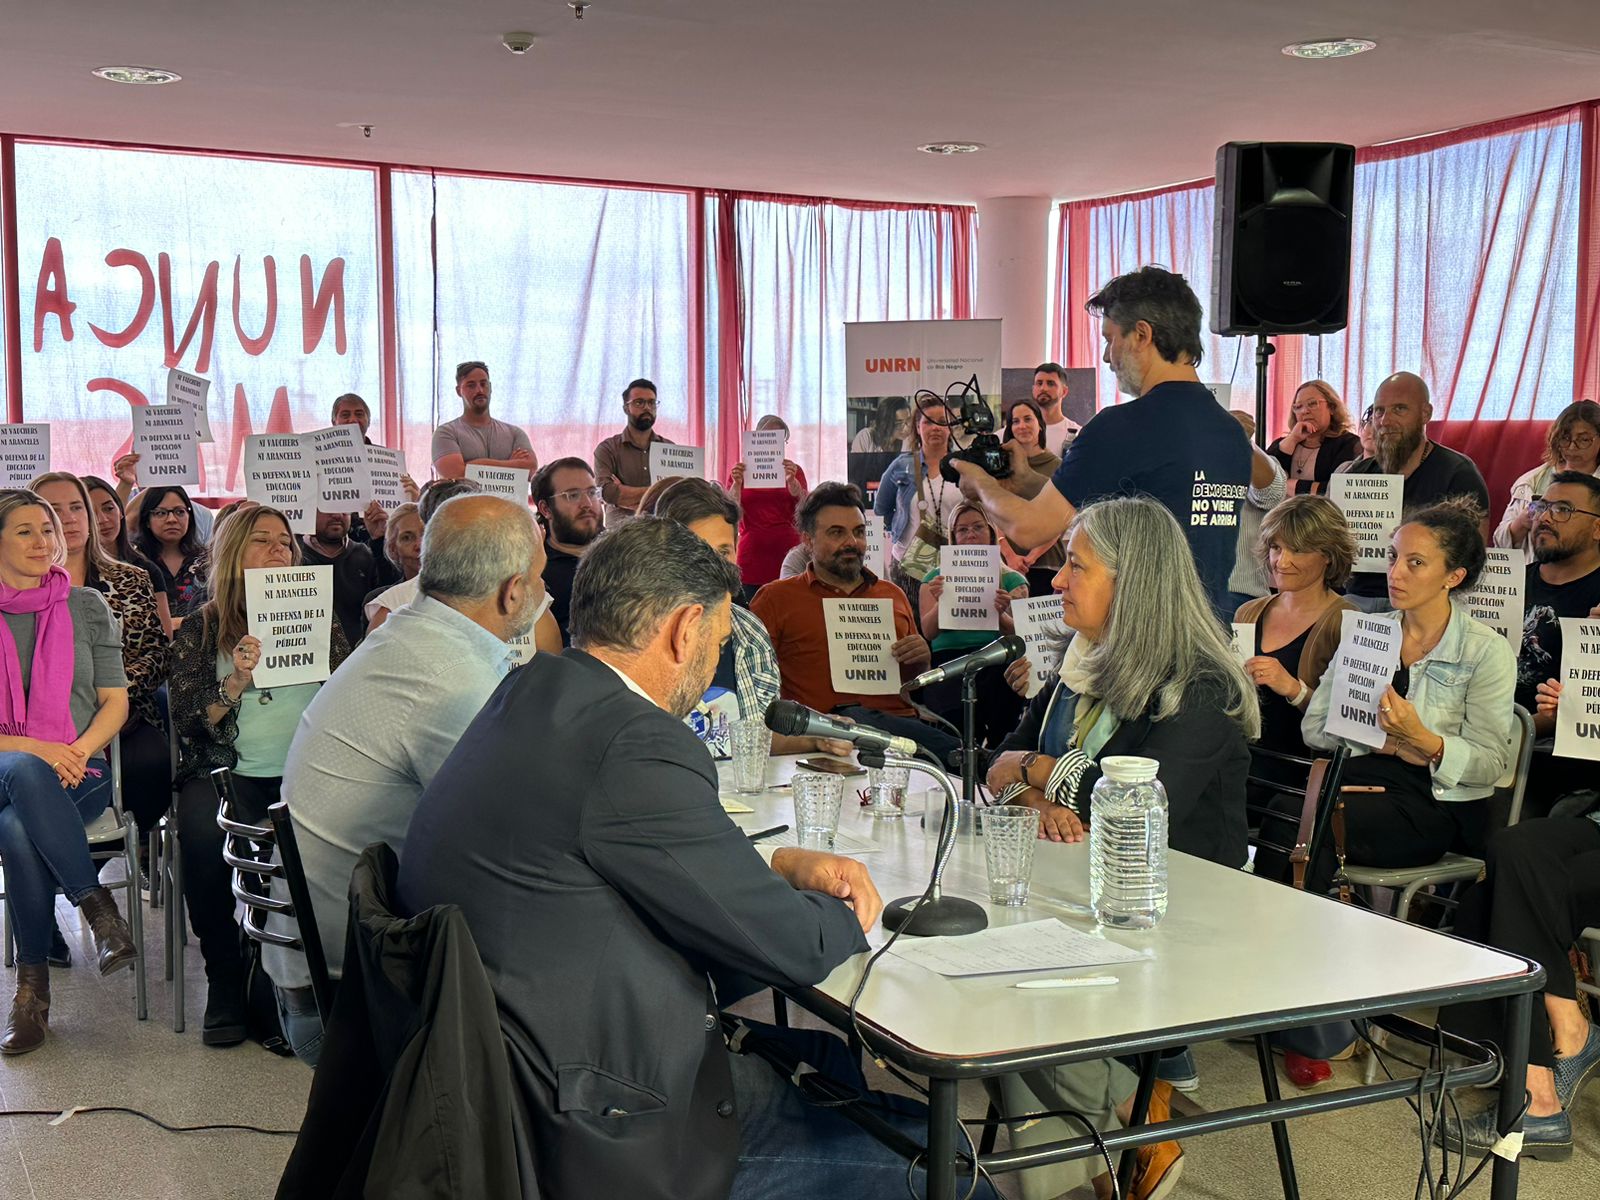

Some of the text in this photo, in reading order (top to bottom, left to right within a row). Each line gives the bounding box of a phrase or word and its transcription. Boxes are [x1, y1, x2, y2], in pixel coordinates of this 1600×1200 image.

[865, 357, 921, 373] UNRN
[259, 439, 299, 447] NI VAUCHERS
[266, 452, 302, 460] ARANCELES
[149, 465, 187, 474] UNRN
[262, 471, 291, 479] DEFENSA
[292, 471, 301, 479] DE
[303, 470, 311, 478] LA
[1195, 470, 1205, 480] LA
[486, 471, 515, 480] VAUCHERS
[1355, 479, 1388, 487] VAUCHERS
[323, 489, 360, 500] UNRN
[1353, 492, 1389, 500] ARANCELES
[378, 500, 400, 509] NRN
[1192, 500, 1234, 512] NO VIENE
[285, 509, 303, 520] RN
[1346, 510, 1373, 518] DEFENSA
[1191, 514, 1208, 526] DE
[1354, 547, 1386, 558] NRN
[1487, 553, 1509, 561] CHERS
[265, 572, 315, 583] NI VAUCHERS
[265, 587, 318, 599] NI ARANCELES
[1497, 587, 1507, 595] DE
[1509, 587, 1517, 596] LA
[847, 604, 879, 612] VAUCHERS
[951, 608, 987, 618] UNRN
[257, 609, 325, 622] EN DEFENSA DE LA
[847, 616, 882, 624] ARANCELES
[1028, 611, 1064, 623] NI ARANCE
[1357, 619, 1391, 636] NI VAUCHERS
[1580, 625, 1589, 636] NI
[835, 632, 843, 640] EN
[845, 632, 871, 640] DEFENSA
[883, 633, 891, 641] LA
[1024, 634, 1033, 642] EN
[1352, 635, 1389, 652] NI ARANCELES
[1580, 643, 1588, 654] NI
[266, 652, 314, 669] UNRN
[1342, 656, 1349, 666] EN
[1350, 658, 1371, 672] DEFENSA
[1372, 664, 1379, 675] DE
[1380, 666, 1388, 677] LA
[845, 669, 887, 681] UNRN
[1569, 668, 1580, 679] EN
[1341, 704, 1376, 727] UNRN
